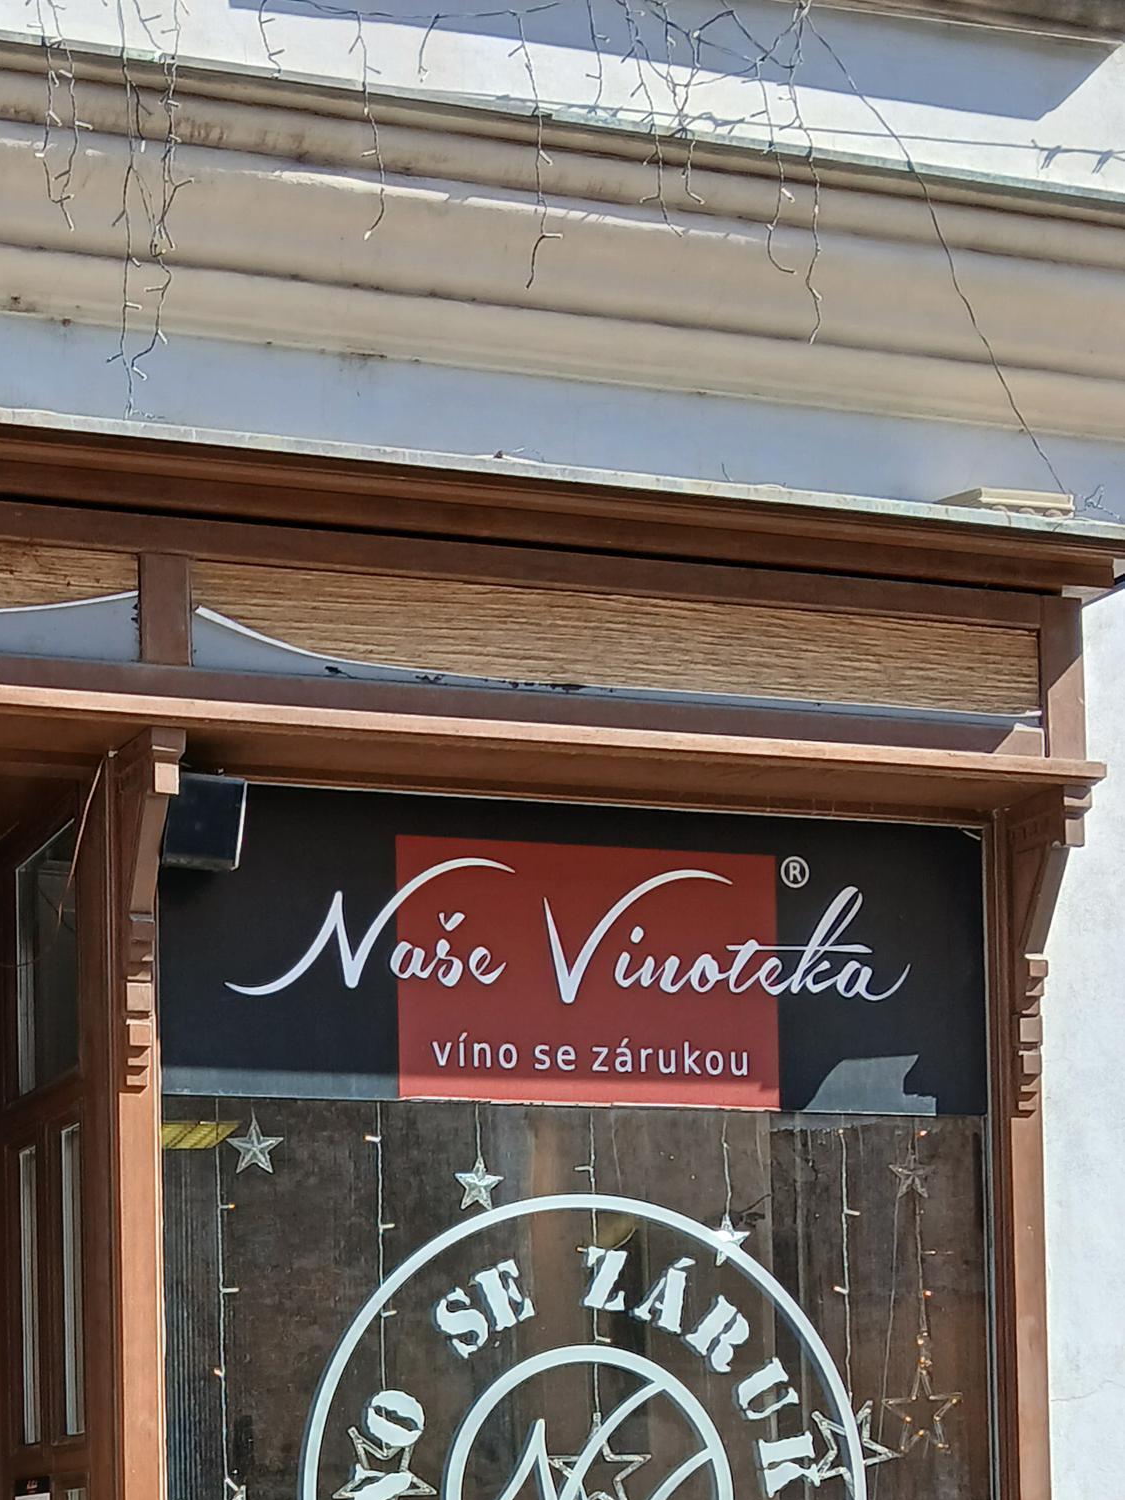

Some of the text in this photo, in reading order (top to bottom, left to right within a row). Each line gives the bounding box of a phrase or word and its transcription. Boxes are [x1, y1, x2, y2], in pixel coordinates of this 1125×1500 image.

[225, 857, 516, 995] Naše
[543, 869, 911, 1004] Vinoteka
[432, 1033, 750, 1077] víno se zárukou
[432, 1258, 536, 1359] SE
